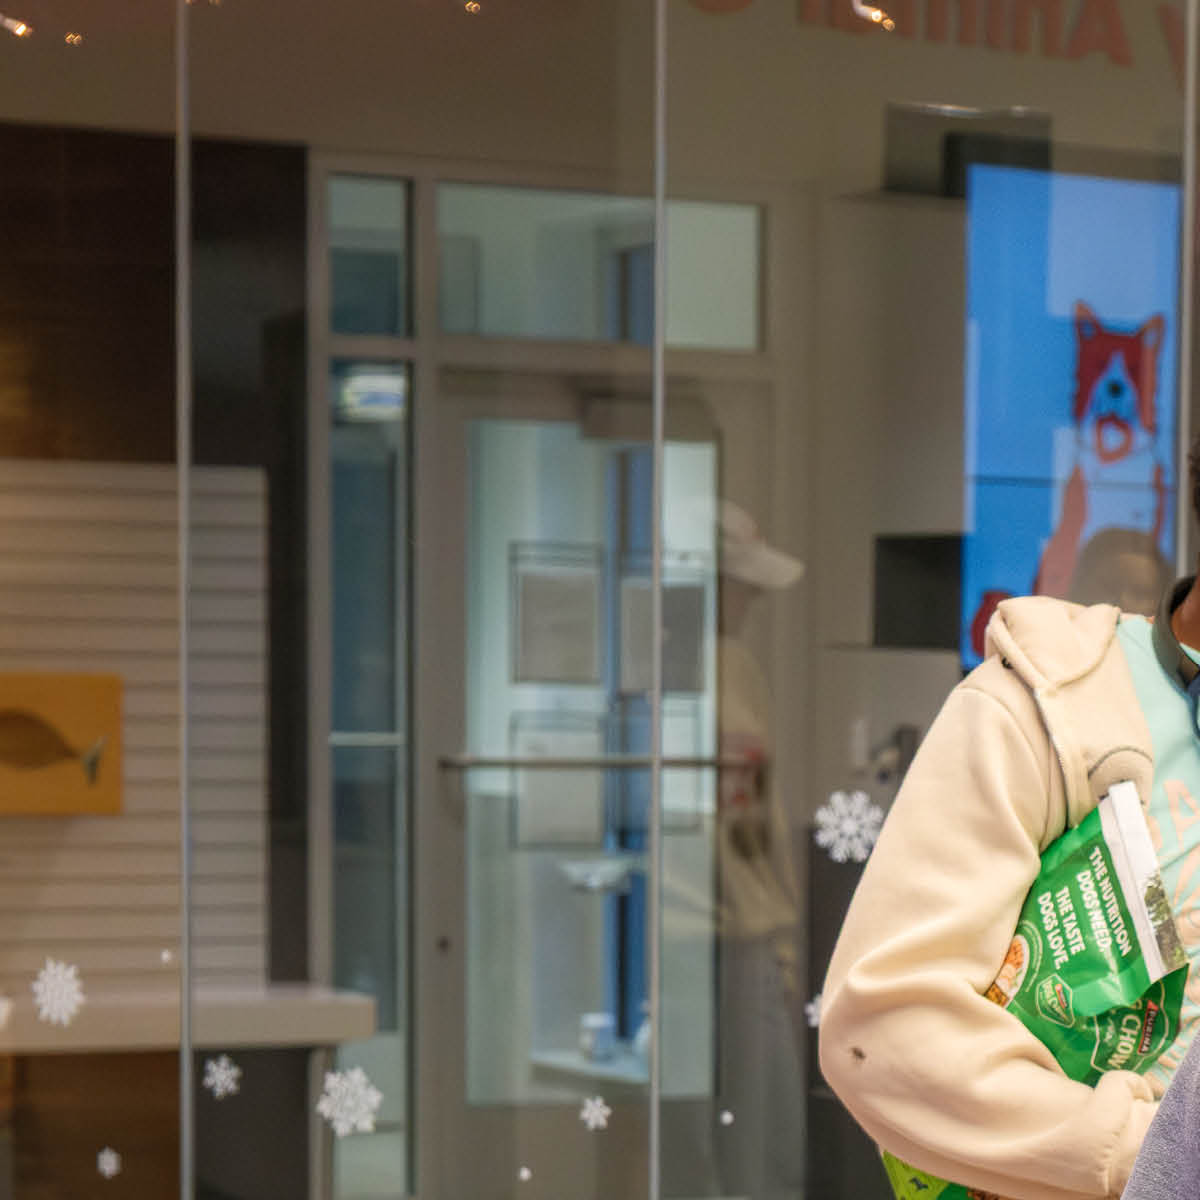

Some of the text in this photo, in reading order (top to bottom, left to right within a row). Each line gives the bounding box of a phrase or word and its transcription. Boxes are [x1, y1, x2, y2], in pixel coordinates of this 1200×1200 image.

[1038, 892, 1059, 931] DOGS
[1076, 870, 1101, 910] DOGS
[1089, 847, 1132, 957] THE NUTRITION
[1056, 886, 1086, 955] THE TASTE
